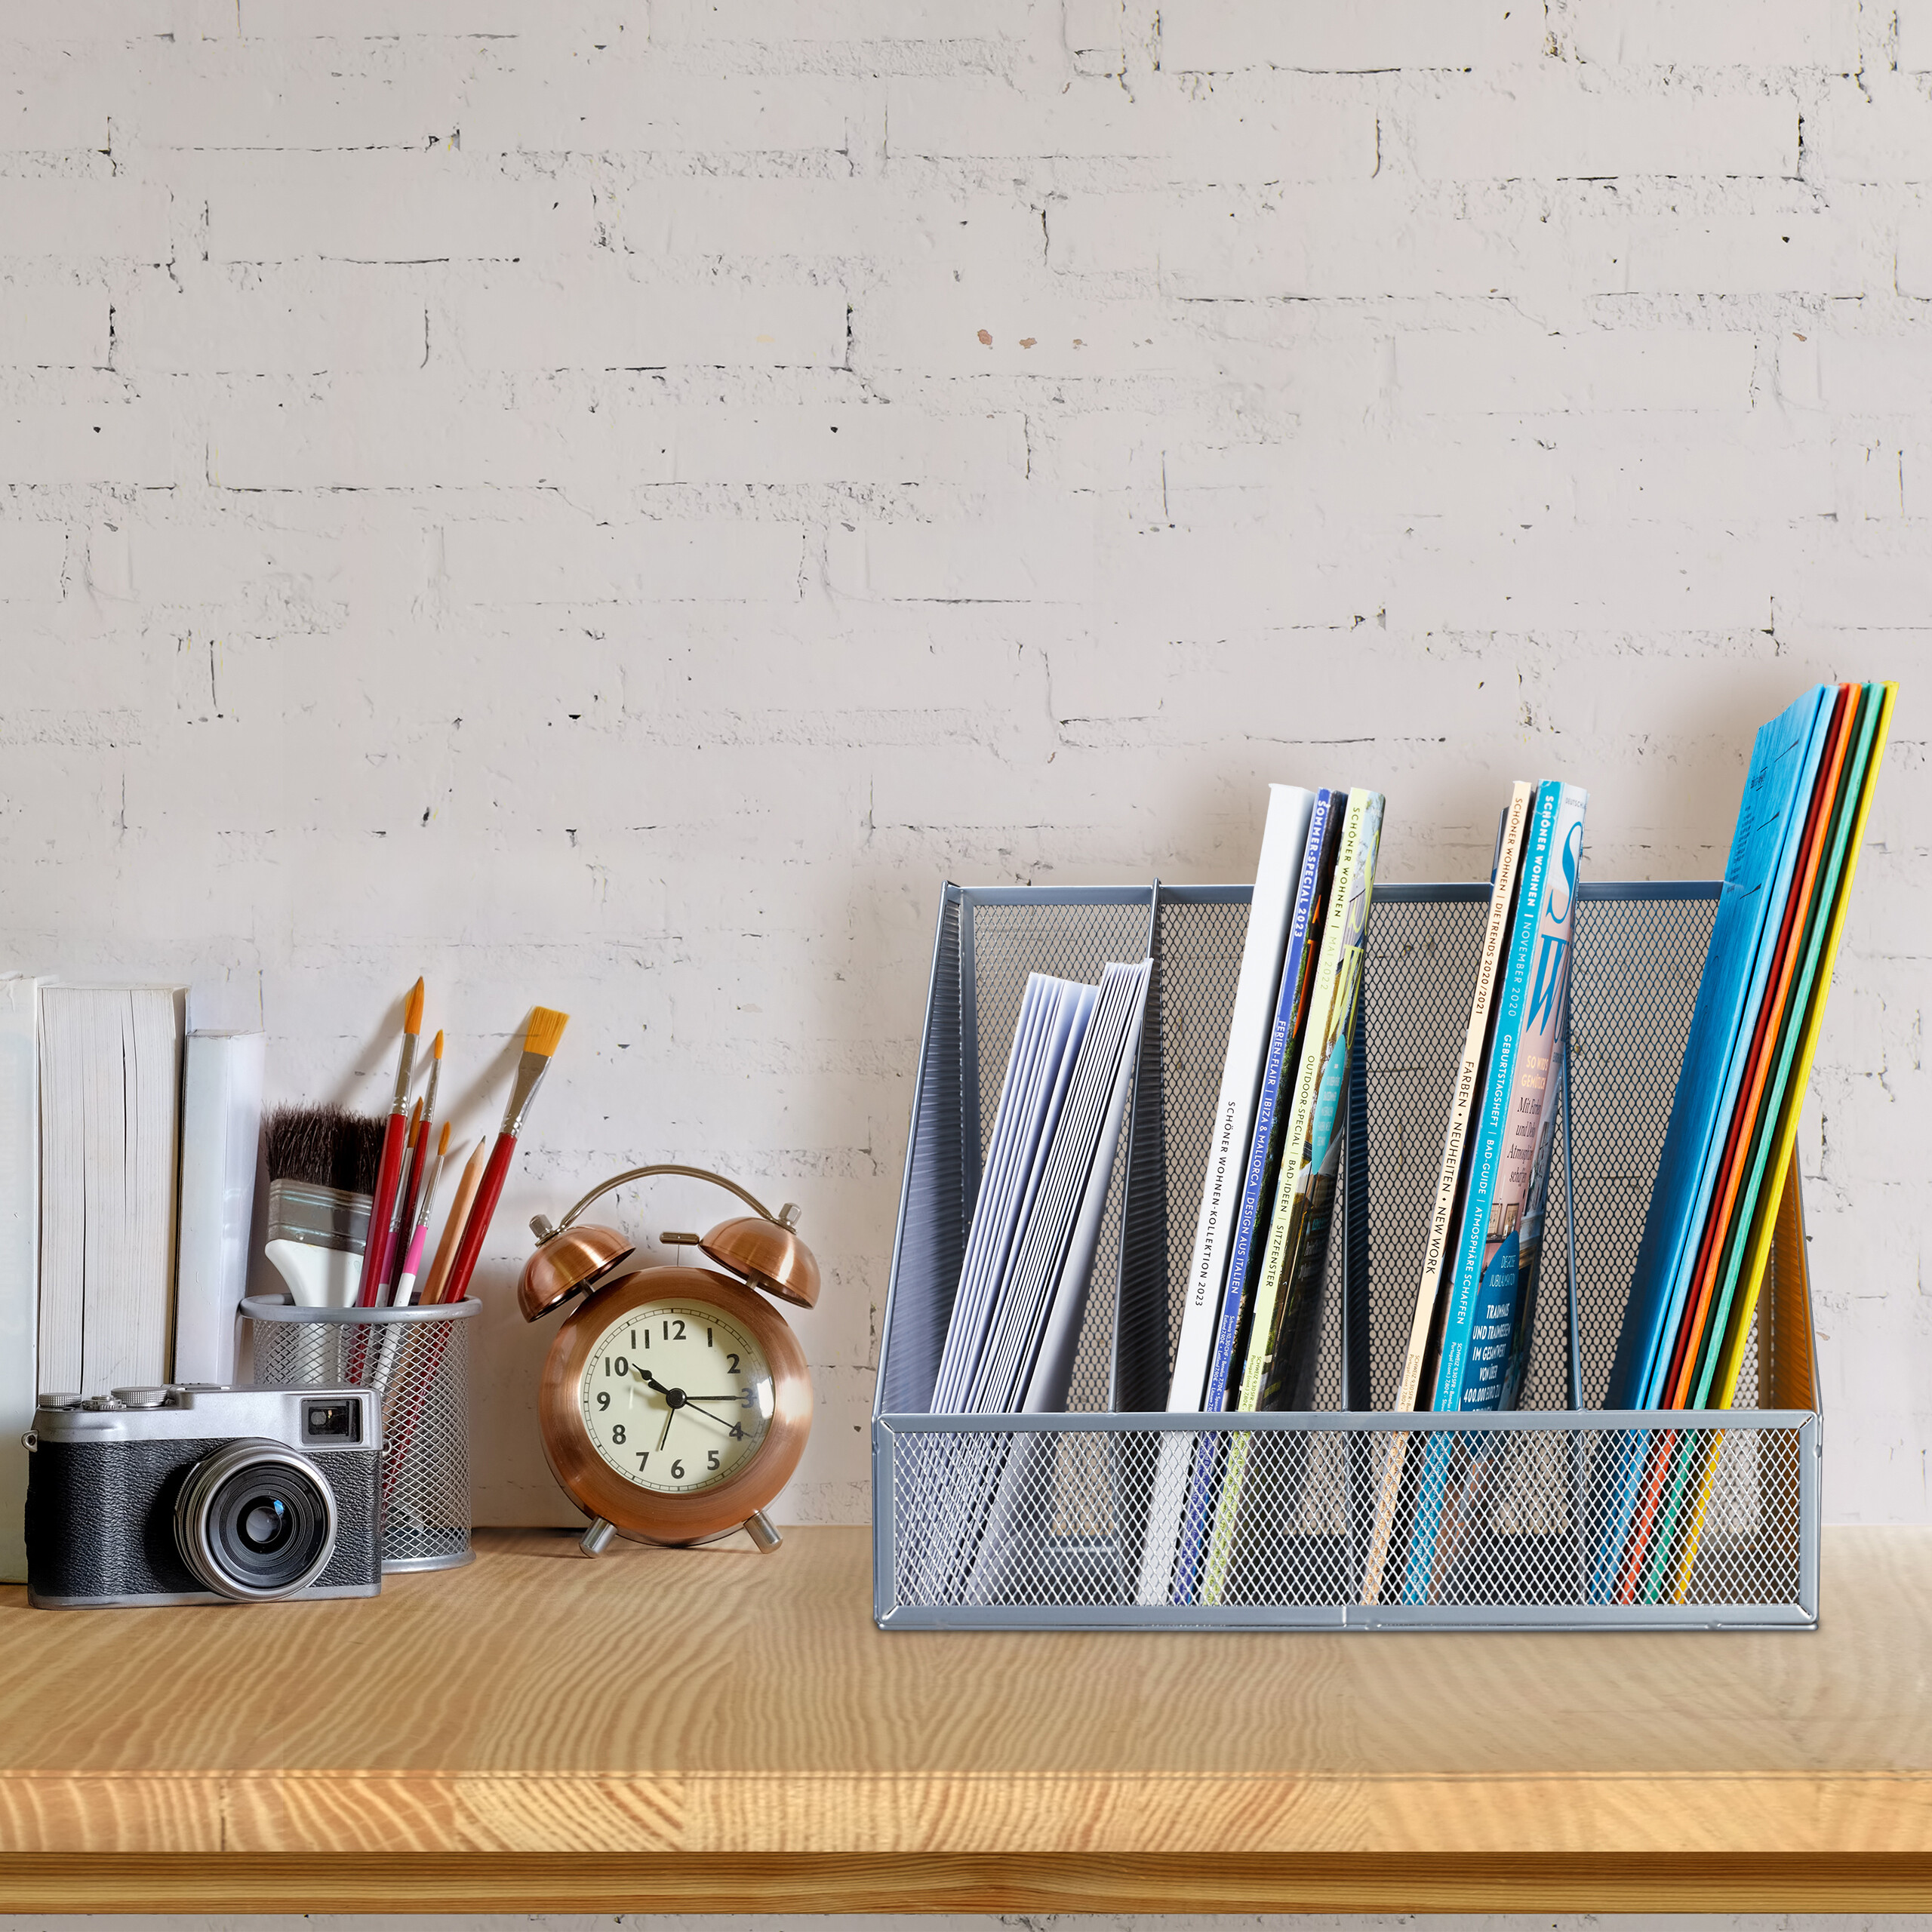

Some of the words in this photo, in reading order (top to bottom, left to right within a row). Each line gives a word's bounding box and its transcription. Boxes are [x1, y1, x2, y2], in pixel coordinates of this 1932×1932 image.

[1343, 808, 1361, 862] SCHÖNER
[1507, 797, 1523, 844] SCHÖNER
[1537, 795, 1554, 851] SCHÖNER
[1300, 800, 1328, 903] SOMMER-SPECIAL
[1499, 848, 1514, 891] WOHNEN
[1334, 867, 1349, 918] WOHNEN
[1527, 856, 1543, 906] WOHNEN
[1294, 908, 1307, 937] 2023
[1494, 903, 1503, 918] DIE
[1327, 936, 1337, 957] MAI
[1486, 921, 1500, 958] TRENDS
[1513, 921, 1531, 983] NOVEMBER
[1321, 961, 1333, 990] 2022
[1475, 960, 1493, 1015] 2020/2021
[1508, 987, 1520, 1017] 2020
[1268, 1020, 1286, 1085] FERIEN-FLAIR
[1457, 1060, 1475, 1108] FARBEN
[1490, 1034, 1512, 1128] GEBURTSTAGSHEFT
[1260, 1097, 1272, 1123] IBIZA
[1291, 1055, 1315, 1147] OUTDOOR-SPECIAL
[1220, 1101, 1236, 1153] SCHÖNER
[1250, 1134, 1266, 1186] MALLORCA
[1441, 1121, 1463, 1192] NEUHEITEN
[1478, 1139, 1495, 1195] BAD-GUIDE
[1280, 1159, 1297, 1212] BAD-IDEEN
[1200, 1156, 1227, 1278] WOHNEN-KOLLEKTION
[1241, 1198, 1254, 1235] DESIGN
[1434, 1206, 1447, 1235] NEW
[1238, 1236, 1247, 1256] AUS
[1266, 1225, 1284, 1287] SITZFENSTER
[1425, 1238, 1441, 1275] WORK
[1465, 1207, 1483, 1272] ATMOSPHÄRE
[1195, 1281, 1206, 1306] 2023
[1231, 1257, 1244, 1294] ITALIEN
[1457, 1274, 1472, 1324] SCHAFFEN
[631, 1329, 651, 1349] 11
[663, 1320, 687, 1340] 12
[707, 1327, 713, 1348] 1
[1472, 1325, 1487, 1340] UND
[605, 1355, 629, 1377] 10
[726, 1354, 741, 1374] 2
[1454, 1343, 1463, 1366] SCHWEIZ
[1472, 1346, 1482, 1361] IM
[596, 1391, 611, 1411] 9
[741, 1387, 755, 1408] 3
[612, 1424, 627, 1445] 8
[729, 1421, 744, 1441] 4
[635, 1451, 650, 1472] 7
[670, 1459, 685, 1479] 6
[706, 1450, 721, 1471] 5
